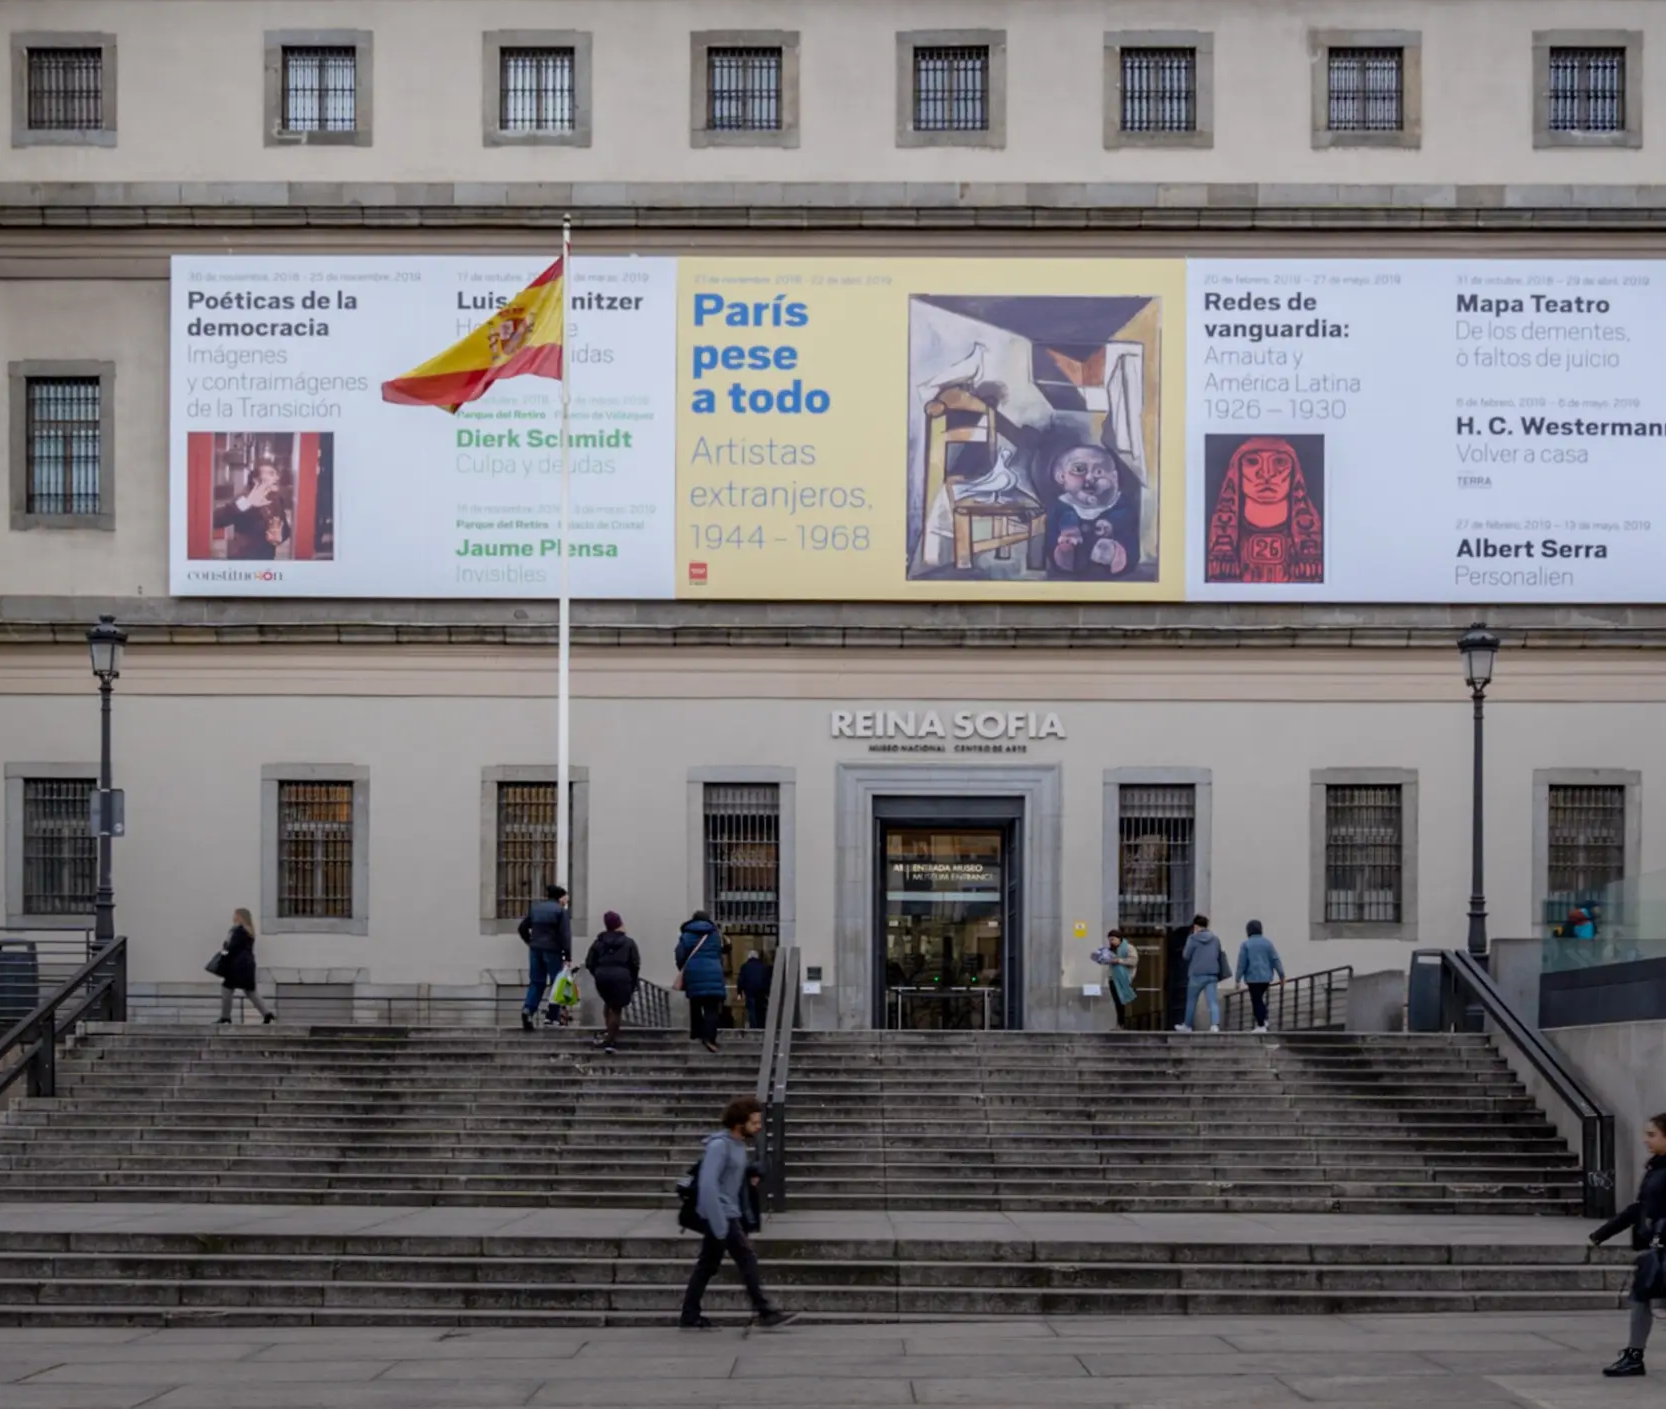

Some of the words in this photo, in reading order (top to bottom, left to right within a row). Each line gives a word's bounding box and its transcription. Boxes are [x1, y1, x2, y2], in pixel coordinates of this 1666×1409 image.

[188, 291, 295, 310] Poéticas
[301, 291, 330, 310] de
[338, 291, 357, 310] la
[457, 292, 507, 310] Luis
[571, 292, 644, 310] nitzer
[693, 293, 809, 328] París
[1205, 292, 1281, 311] Redes
[1287, 292, 1317, 311] de
[1457, 294, 1523, 317] Mapa
[1531, 294, 1610, 313] Teatro
[187, 317, 329, 337] democracia
[1204, 318, 1349, 342] vanguardia:
[1455, 320, 1483, 340] De
[1488, 320, 1517, 340] los
[187, 344, 288, 370] Imágenes
[692, 345, 798, 378] pese
[1204, 346, 1287, 366] Amauta
[1293, 350, 1303, 370] y
[1474, 348, 1531, 367] faltos
[1536, 348, 1561, 367] de
[1565, 348, 1620, 372] juicio
[187, 376, 197, 395] y
[202, 372, 368, 396] contraimágenes
[1204, 372, 1289, 392] América
[1295, 372, 1361, 392] Latina
[691, 388, 715, 414] a
[729, 380, 831, 414] todo
[187, 398, 211, 418] de
[217, 398, 233, 418] la
[237, 397, 341, 418] Transición
[457, 410, 493, 421] Parque
[496, 410, 511, 420] del
[514, 410, 546, 420] Retiro
[1204, 398, 1261, 420] 1926
[1289, 398, 1347, 420] 1930
[1456, 416, 1481, 436] H.
[1489, 416, 1513, 436] C.
[457, 428, 520, 448] Dierk
[691, 436, 816, 466] Artistas
[1455, 444, 1520, 464] Volver
[1524, 448, 1535, 463] a
[1540, 448, 1589, 464] casa
[456, 453, 516, 477] Culpa
[522, 460, 533, 479] y
[690, 480, 873, 516] extranjeros,
[457, 520, 495, 531] Parque
[498, 520, 513, 529] del
[515, 520, 549, 529] Retiro
[689, 524, 765, 550] 1944
[797, 524, 870, 550] 1968
[455, 538, 533, 557] Jaume
[1255, 539, 1279, 556] 26
[1457, 538, 1534, 558] Albert
[1541, 538, 1607, 558] Serra
[456, 564, 546, 584] Invisibles
[1455, 566, 1573, 586] Personalien
[831, 710, 945, 739] REINA
[953, 710, 1067, 739] SOFIA
[913, 864, 951, 872] ENTRADA
[953, 864, 983, 872] MUSEO
